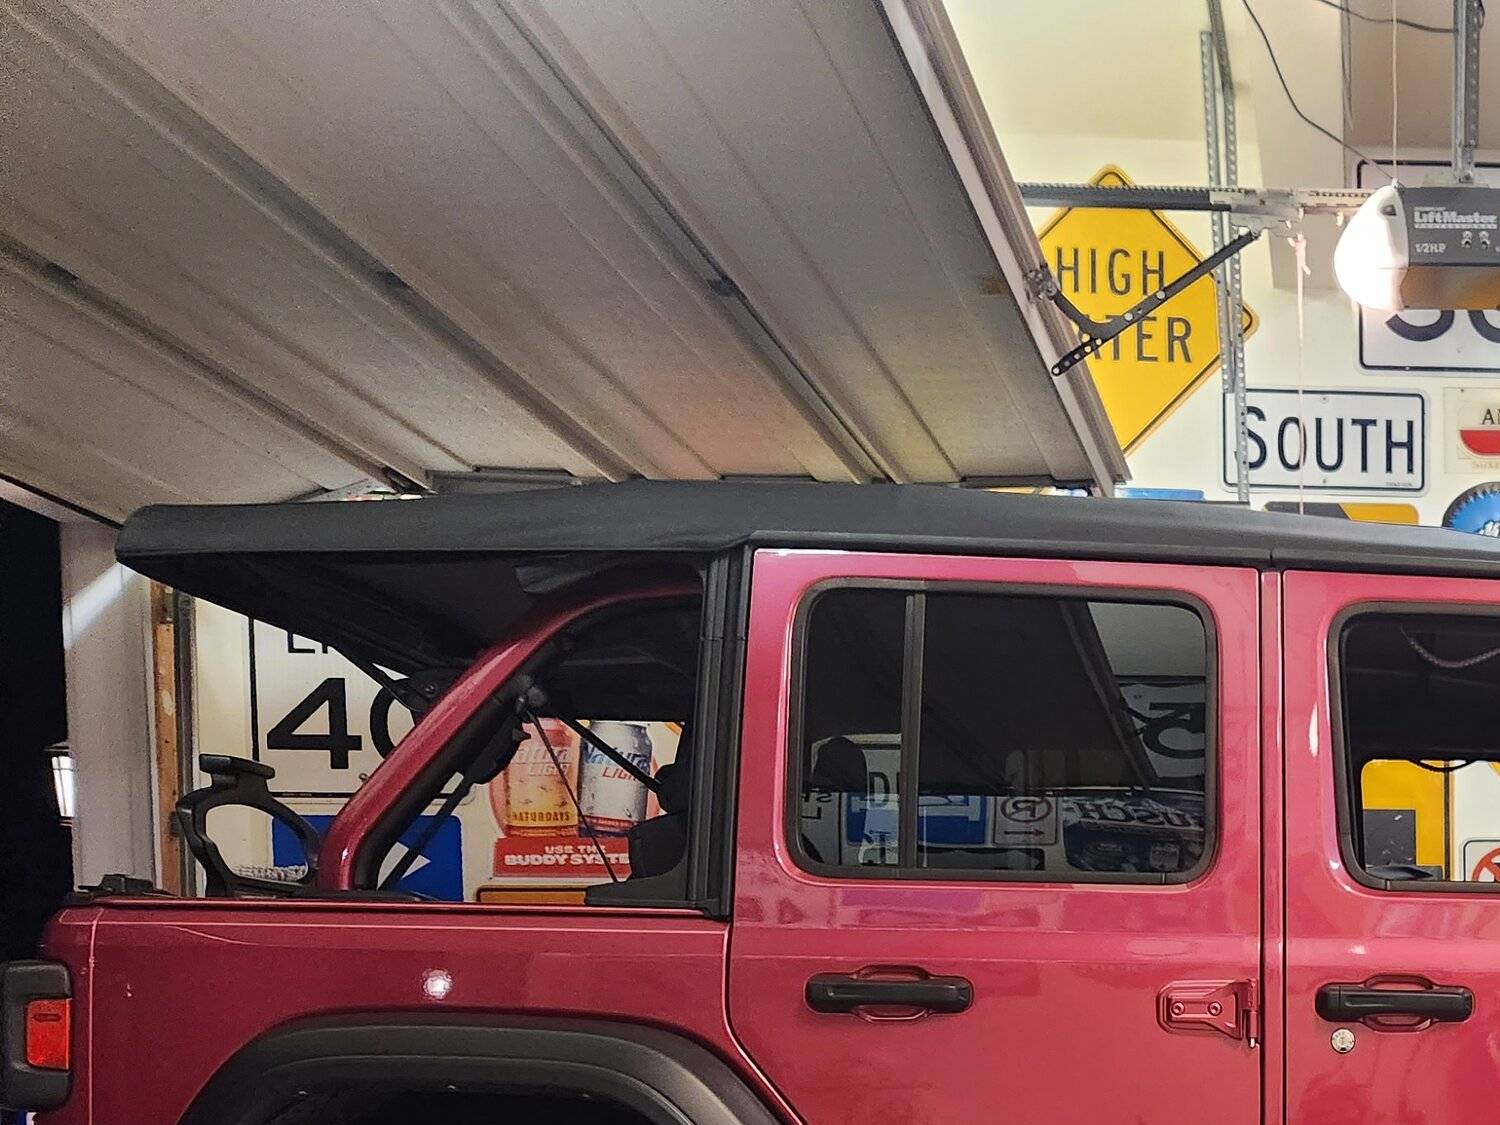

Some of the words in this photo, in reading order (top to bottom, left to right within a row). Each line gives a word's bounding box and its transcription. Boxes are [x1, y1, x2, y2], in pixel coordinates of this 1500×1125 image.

[1413, 210, 1498, 224] LiftMaster
[1056, 247, 1165, 296] HIGH
[1235, 405, 1415, 475] SOUTH
[544, 845, 575, 855] USE
[577, 845, 606, 855] THE
[504, 854, 566, 866] BUDDY
[570, 853, 630, 866] SYSTE
